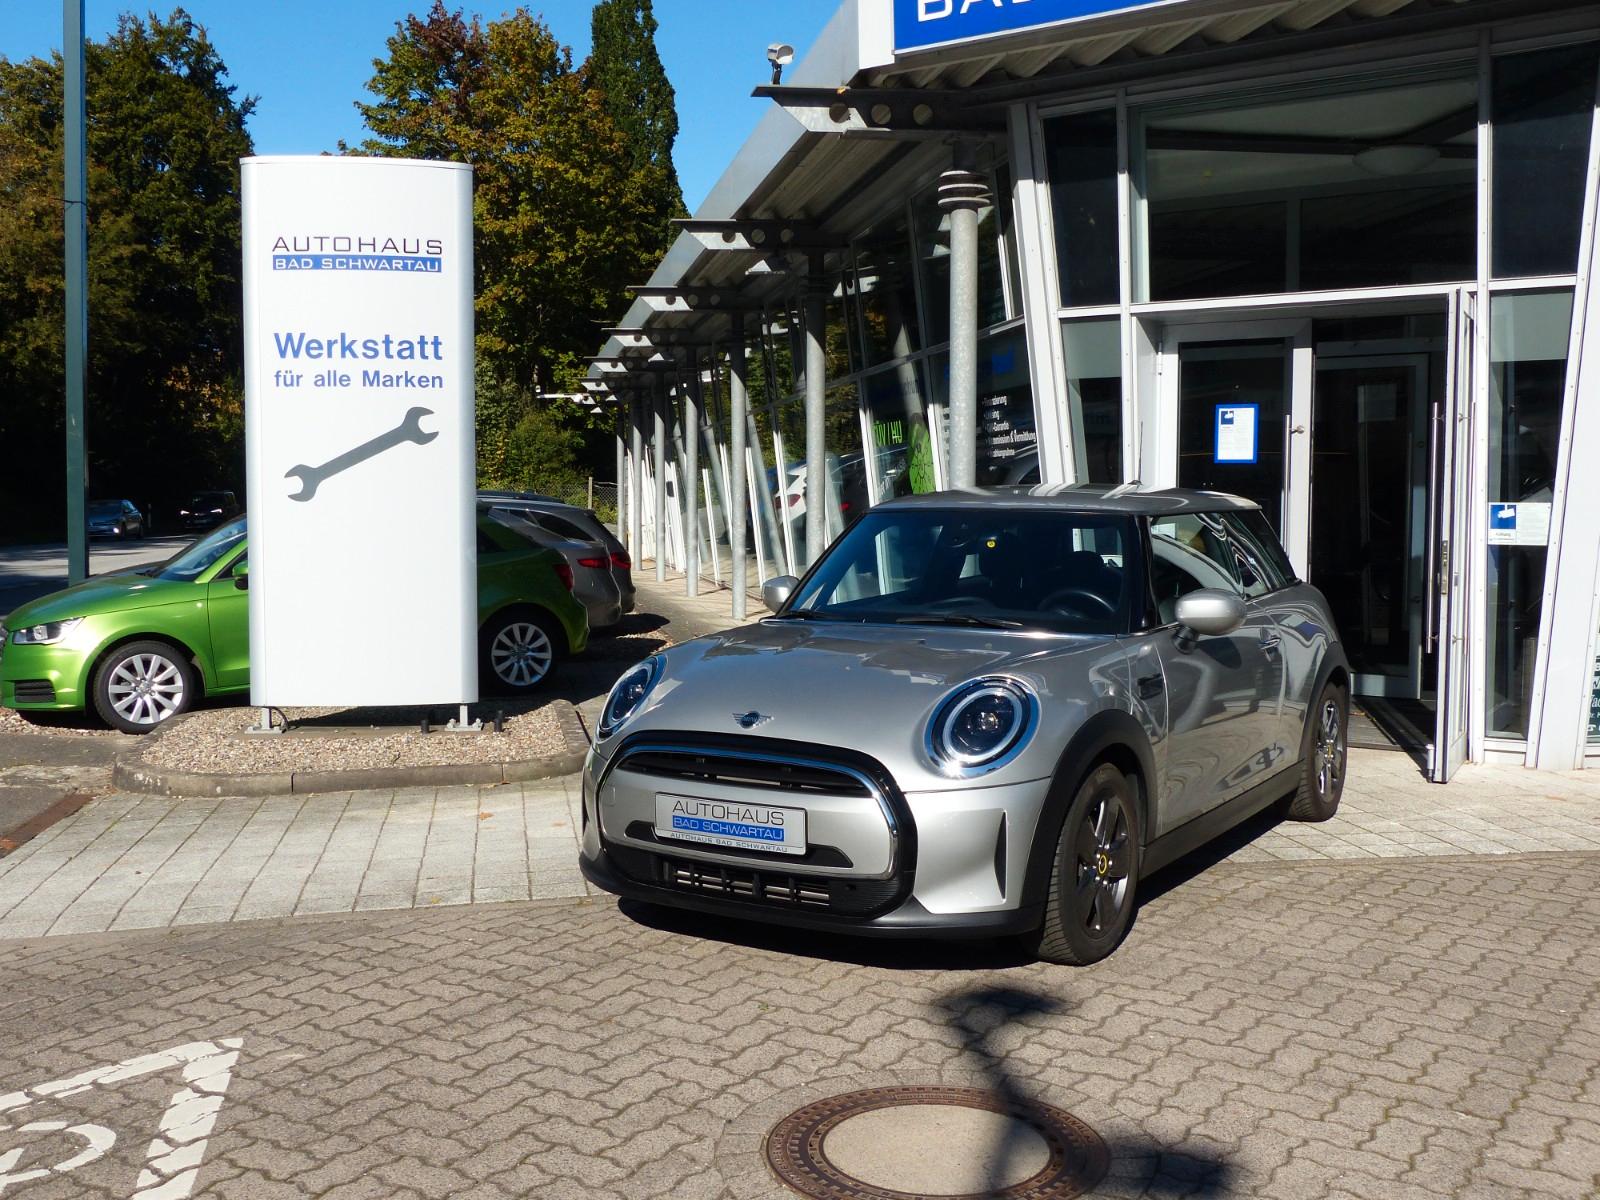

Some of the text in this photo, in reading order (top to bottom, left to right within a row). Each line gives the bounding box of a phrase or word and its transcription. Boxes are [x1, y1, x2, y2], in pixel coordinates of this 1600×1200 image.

[272, 236, 443, 254] AUTOHAUS
[275, 258, 439, 272] BAD SCHWARTAU
[273, 332, 443, 361] Werkstatt
[274, 370, 443, 389] für alle Marken
[672, 800, 785, 825] AUTOHAUS
[674, 817, 783, 840] BAD SCHWARTAU
[670, 832, 788, 852] AUTOHAUS BAD SCHWARTAU
